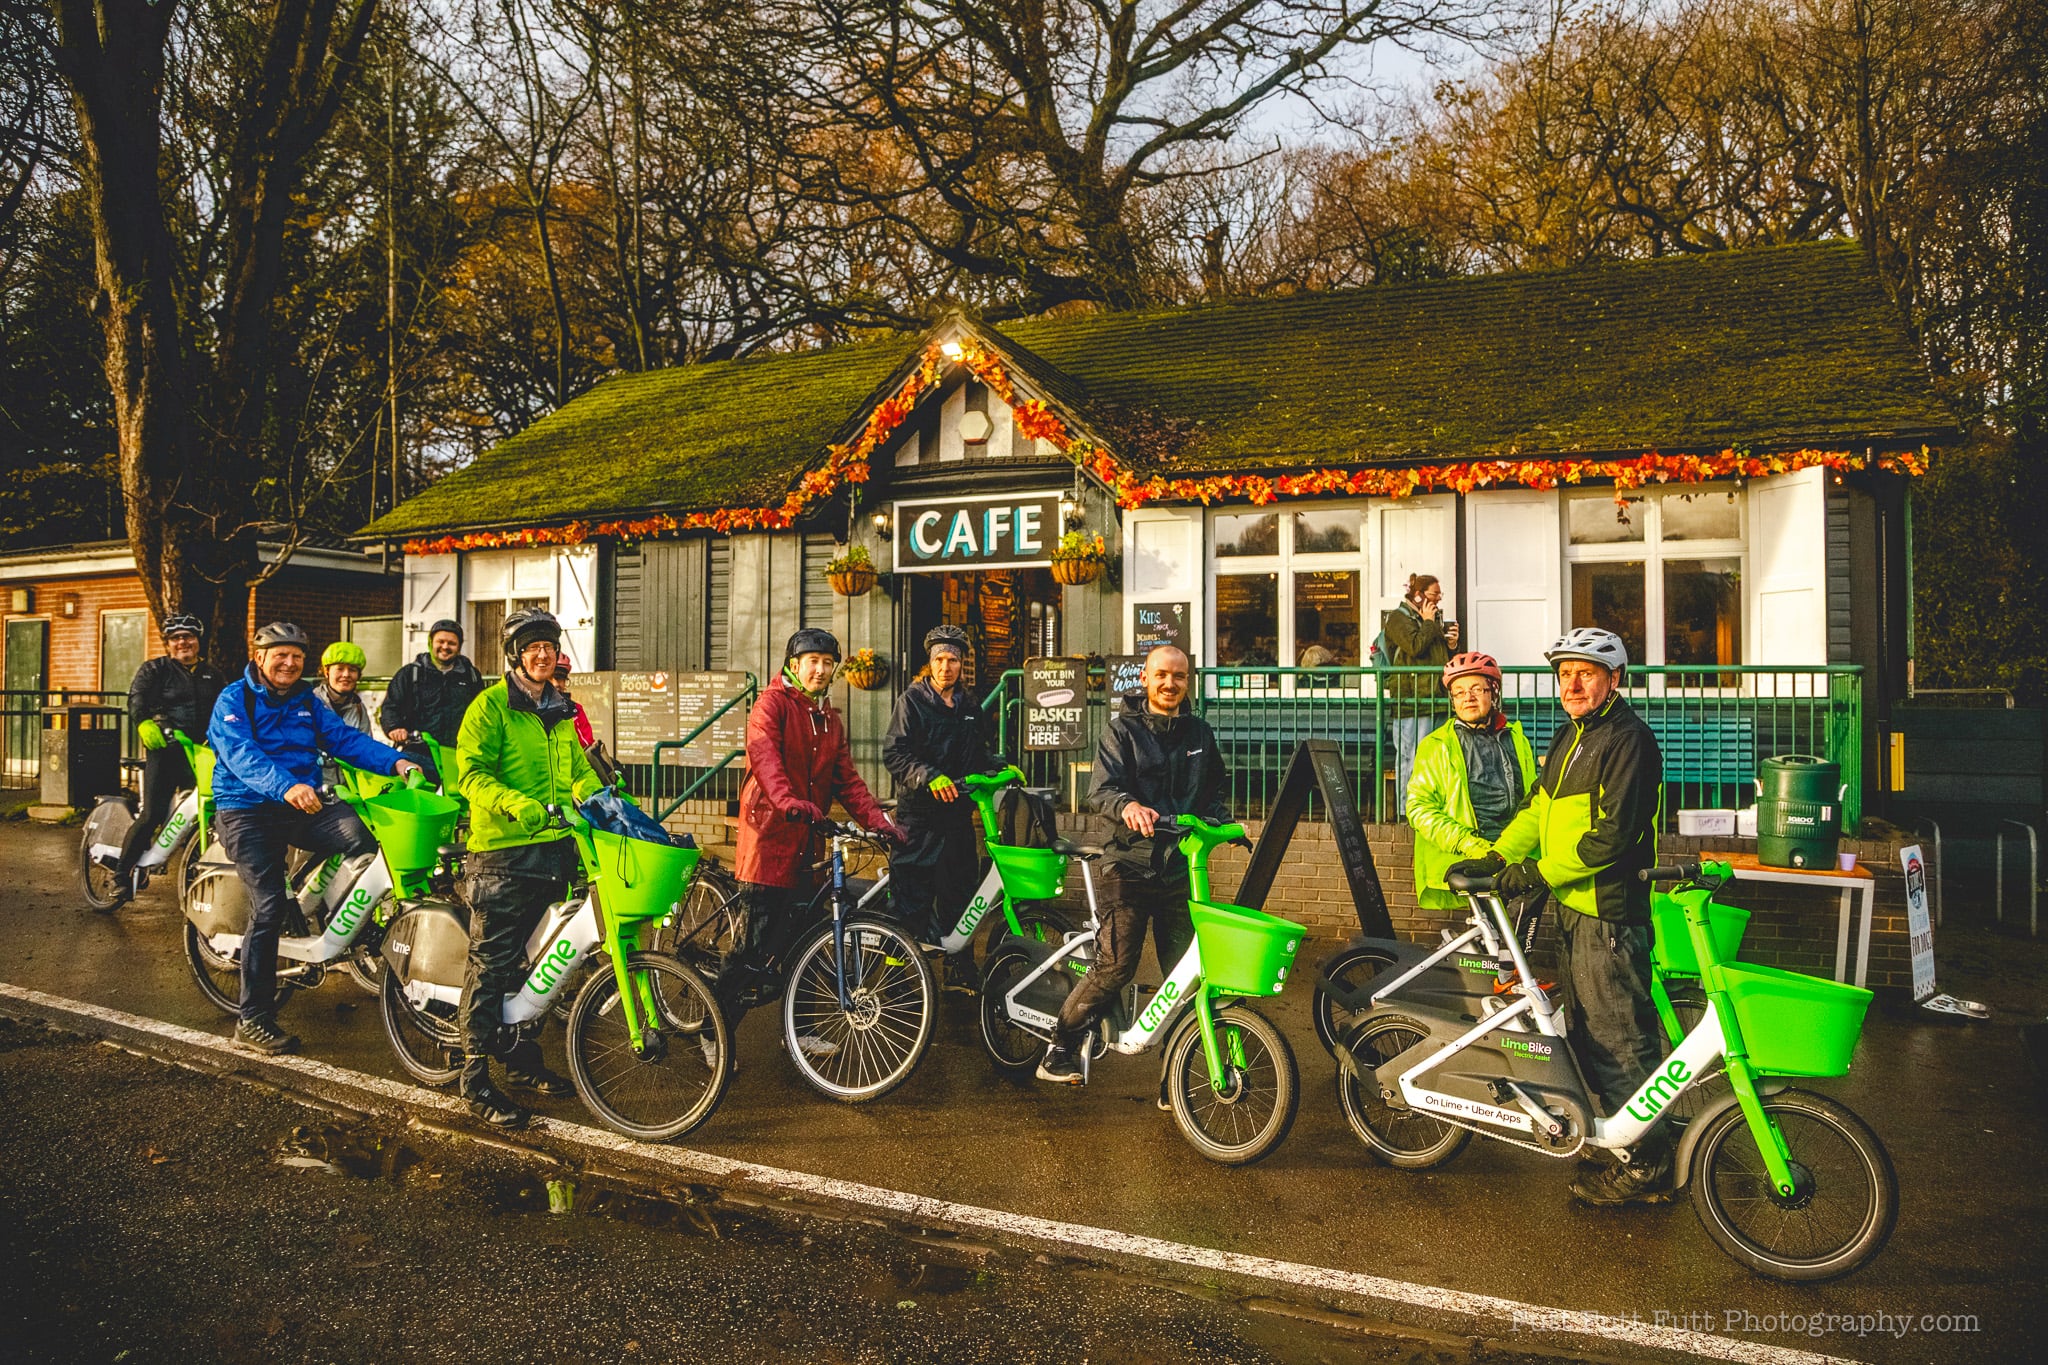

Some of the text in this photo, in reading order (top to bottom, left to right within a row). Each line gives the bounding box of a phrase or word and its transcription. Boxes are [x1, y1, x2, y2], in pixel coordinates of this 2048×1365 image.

[912, 505, 1042, 557] CAFE
[1033, 670, 1075, 680] DON'T BIN
[621, 681, 650, 691] FOOD
[1029, 708, 1083, 722] BASKET
[1029, 723, 1045, 732] Drop
[1046, 723, 1052, 731] it
[1028, 732, 1060, 745] HERE
[329, 888, 372, 936] Lime
[955, 895, 988, 936] Lime
[392, 939, 411, 955] Lime
[527, 939, 577, 995] Lime
[1459, 958, 1499, 970] LimeBike
[1138, 981, 1180, 1032] Lime
[1019, 1009, 1028, 1017] On
[1028, 1012, 1041, 1022] Lime
[1501, 1037, 1552, 1055] LimeBike
[1514, 1051, 1551, 1062] Electric Assist
[1626, 1060, 1692, 1122] Lime
[1425, 1095, 1439, 1106] On
[1440, 1099, 1462, 1110] Lime
[1471, 1105, 1494, 1117] Uber
[1496, 1110, 1521, 1124] Apps
